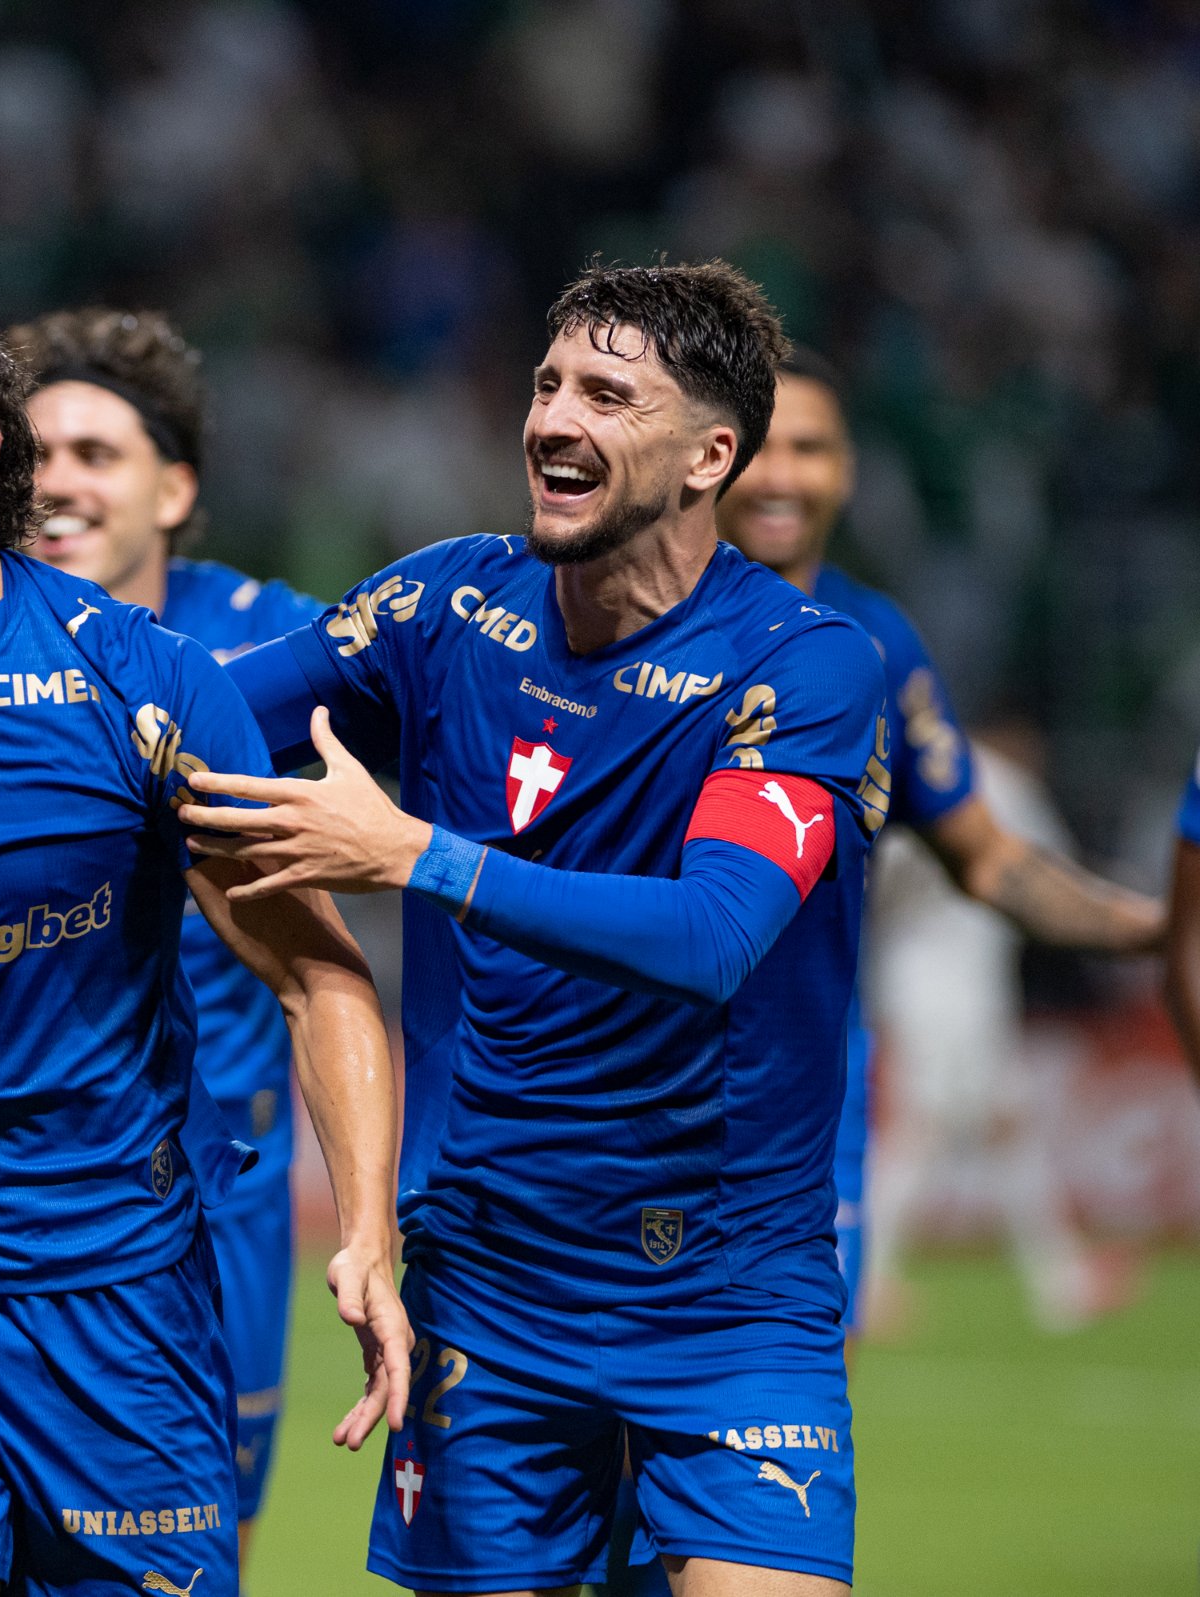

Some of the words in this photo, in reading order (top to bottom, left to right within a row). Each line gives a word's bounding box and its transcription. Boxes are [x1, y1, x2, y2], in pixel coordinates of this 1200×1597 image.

[451, 585, 538, 652] CMED
[519, 676, 587, 717] Embracon
[62, 1503, 222, 1536] UNIASSELVI
